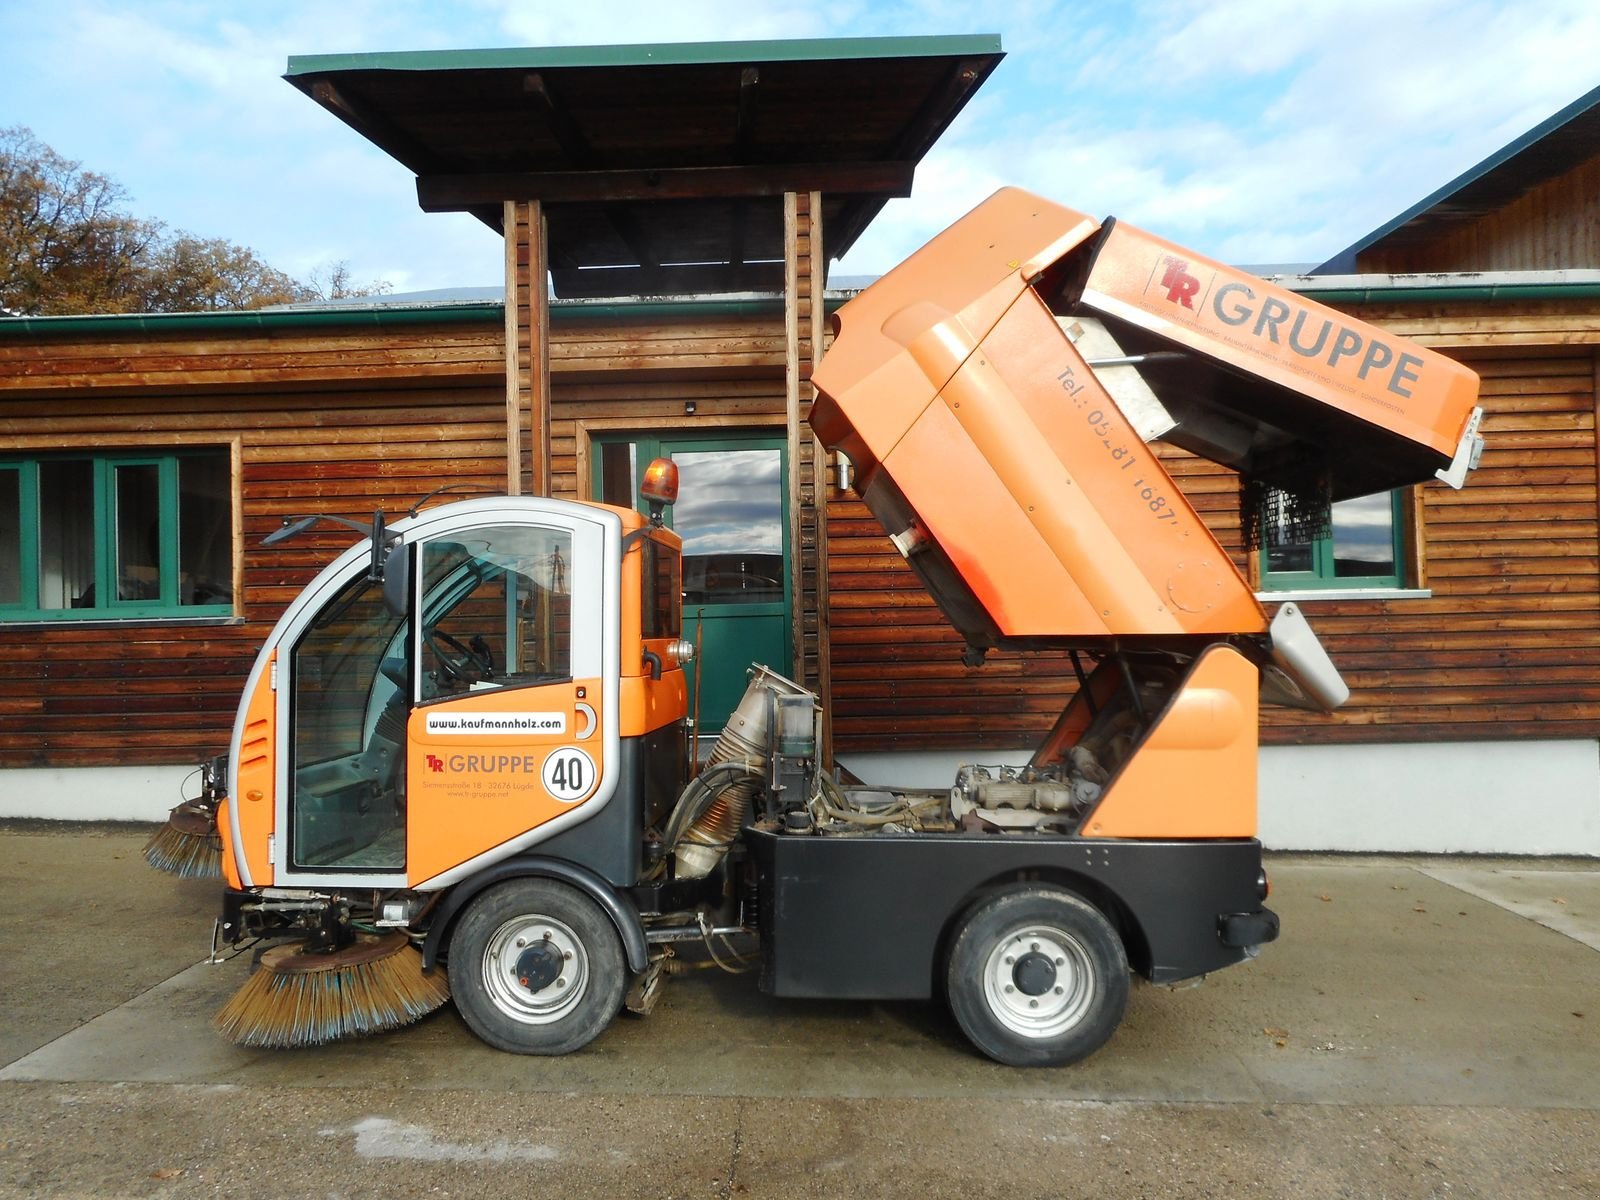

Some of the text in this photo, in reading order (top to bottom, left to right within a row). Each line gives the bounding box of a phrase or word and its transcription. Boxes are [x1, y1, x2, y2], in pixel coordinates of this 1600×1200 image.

[1213, 282, 1425, 399] GRUPPE
[1057, 366, 1088, 409] Tel.:
[429, 718, 562, 729] www.kaufmannholz.com
[449, 755, 534, 773] GRUPPE
[551, 757, 583, 791] 40
[488, 782, 511, 790] 32676
